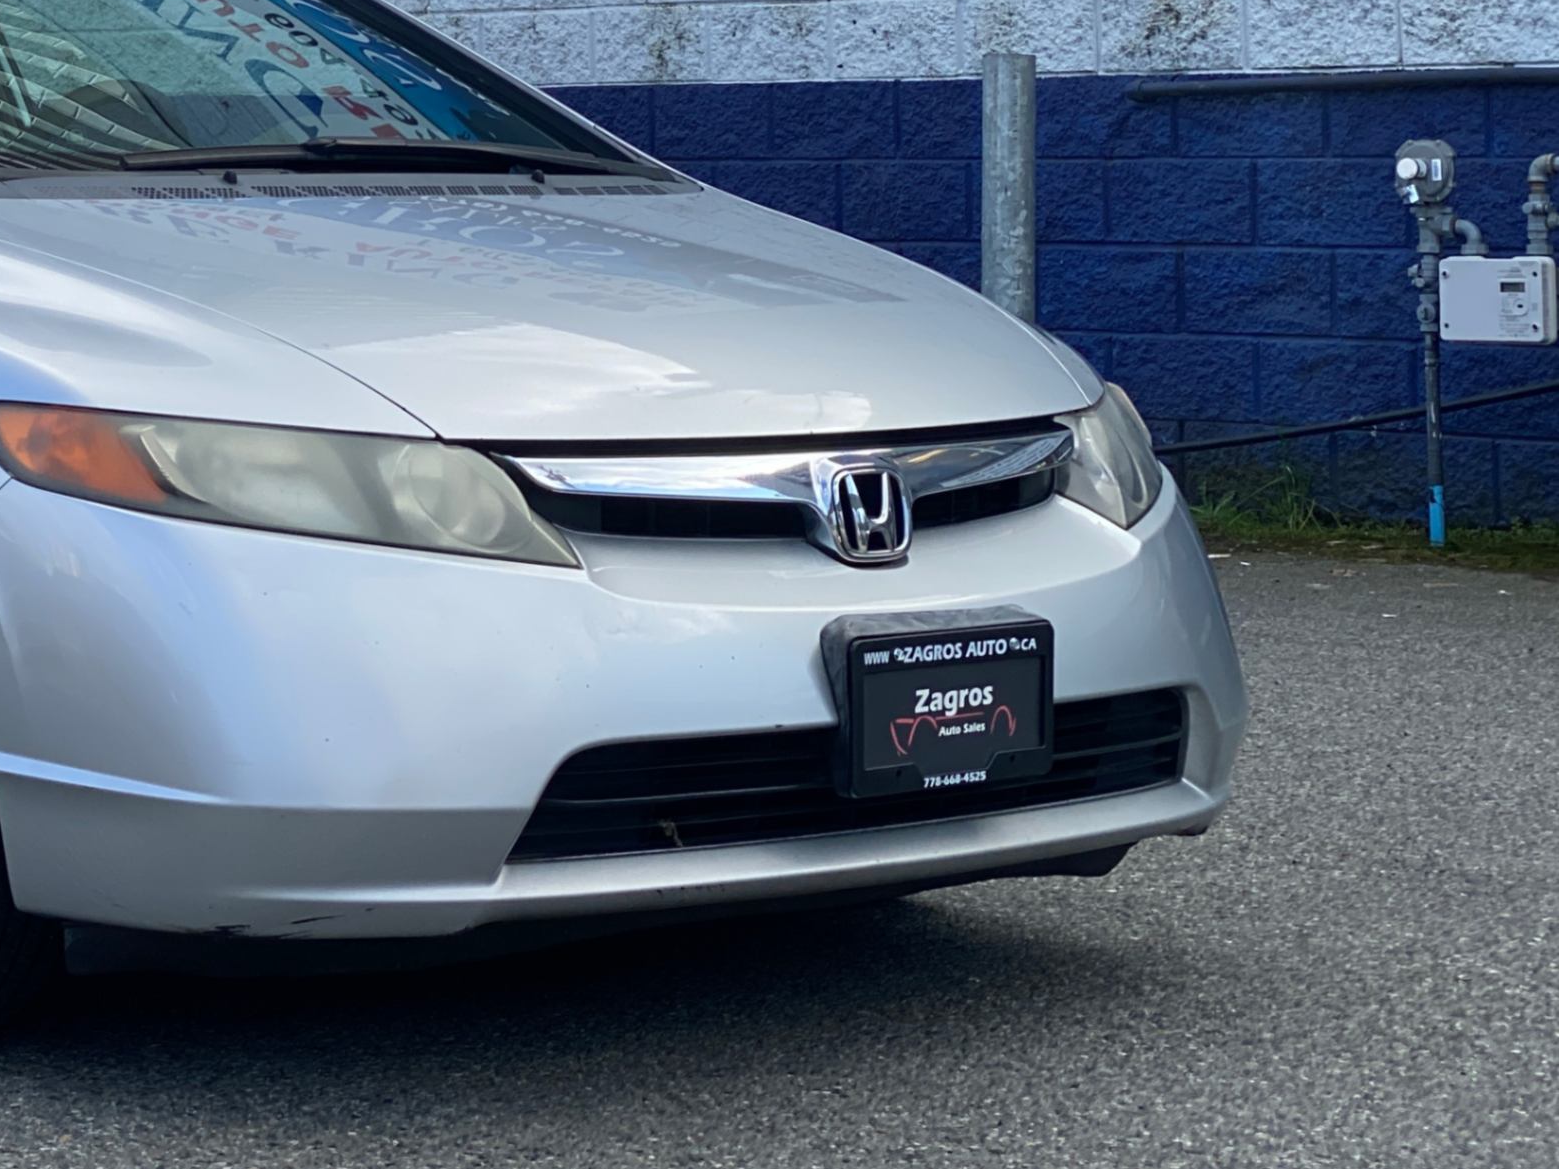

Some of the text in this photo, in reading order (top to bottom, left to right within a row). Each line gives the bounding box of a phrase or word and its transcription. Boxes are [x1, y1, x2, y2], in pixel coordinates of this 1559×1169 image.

[914, 686, 993, 716] Zagros
[938, 722, 986, 737] Auto Sales
[923, 770, 987, 788] 778-668-4525
